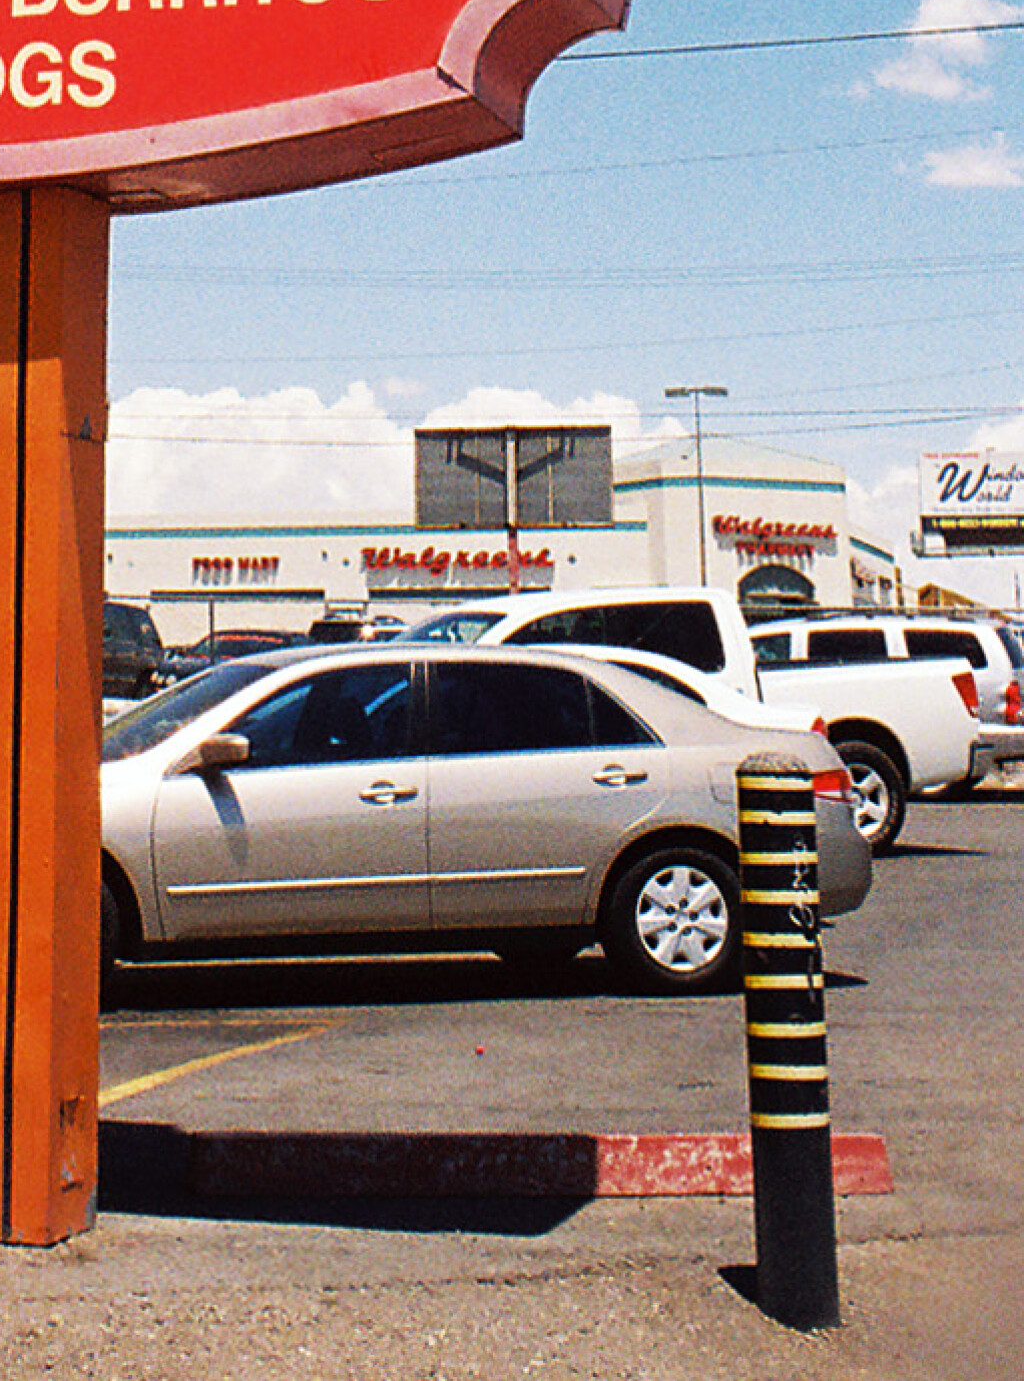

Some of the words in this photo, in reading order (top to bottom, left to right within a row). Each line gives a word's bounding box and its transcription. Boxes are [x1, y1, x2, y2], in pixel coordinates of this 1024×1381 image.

[712, 515, 837, 540] Walgreens
[192, 557, 233, 571] FOOD
[238, 557, 279, 571] MART
[360, 546, 555, 576] Walgreens
